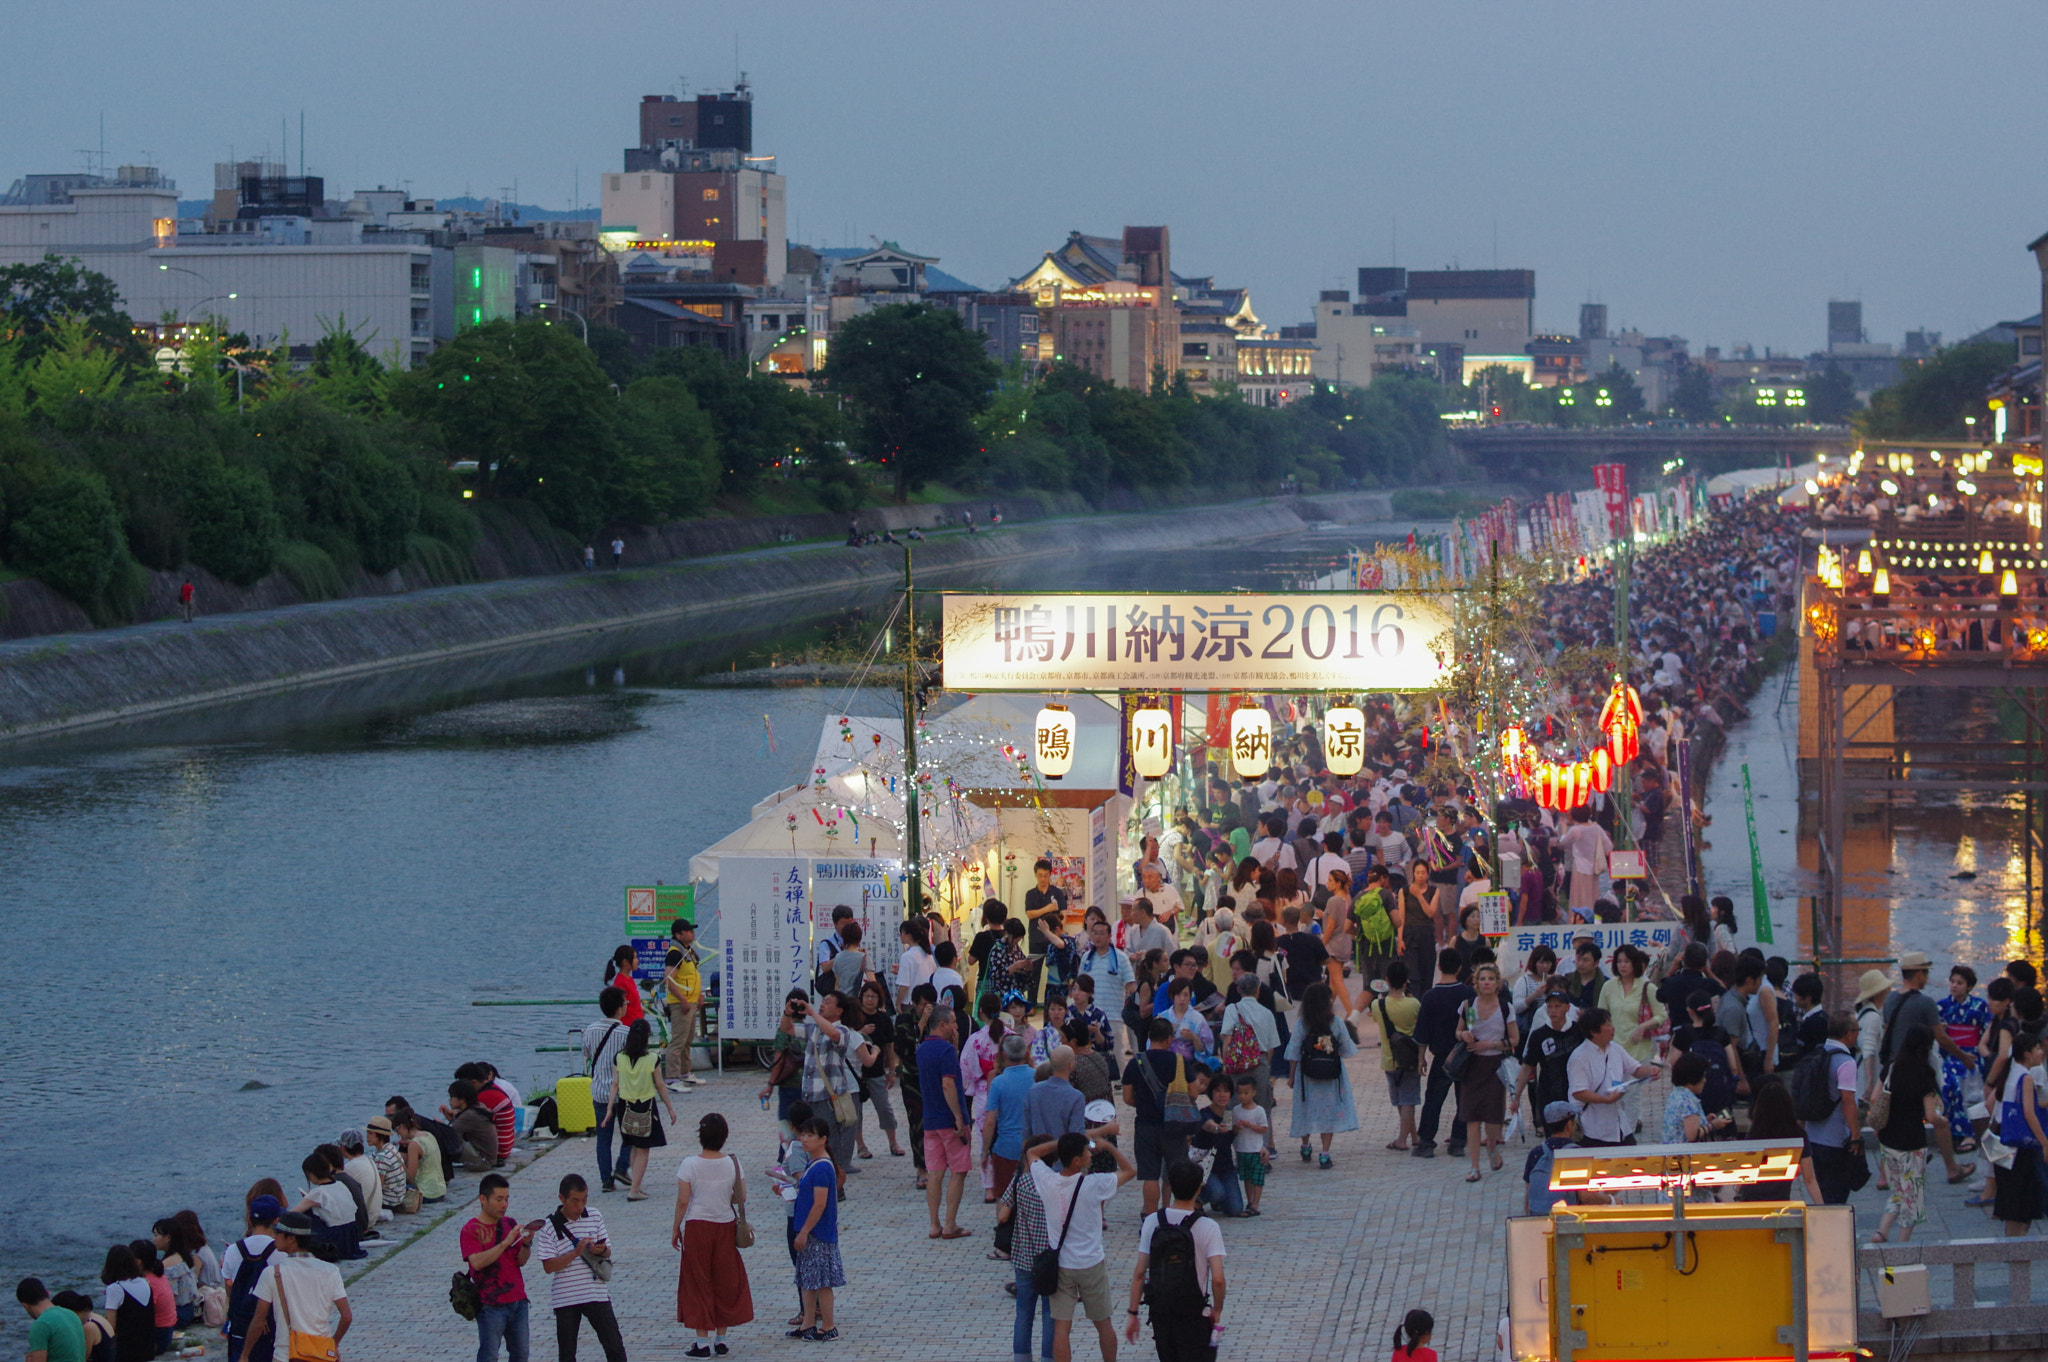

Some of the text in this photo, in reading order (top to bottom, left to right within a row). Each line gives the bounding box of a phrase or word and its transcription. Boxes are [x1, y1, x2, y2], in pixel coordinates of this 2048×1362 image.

[994, 603, 1405, 662] 鴨川納涼2016
[1038, 723, 1070, 761] 鴨
[1136, 723, 1169, 760] 川
[1235, 725, 1269, 761] 納
[1328, 722, 1361, 758] 涼
[816, 863, 882, 879] 鴨川納涼
[785, 865, 805, 990] 友禅流しファン
